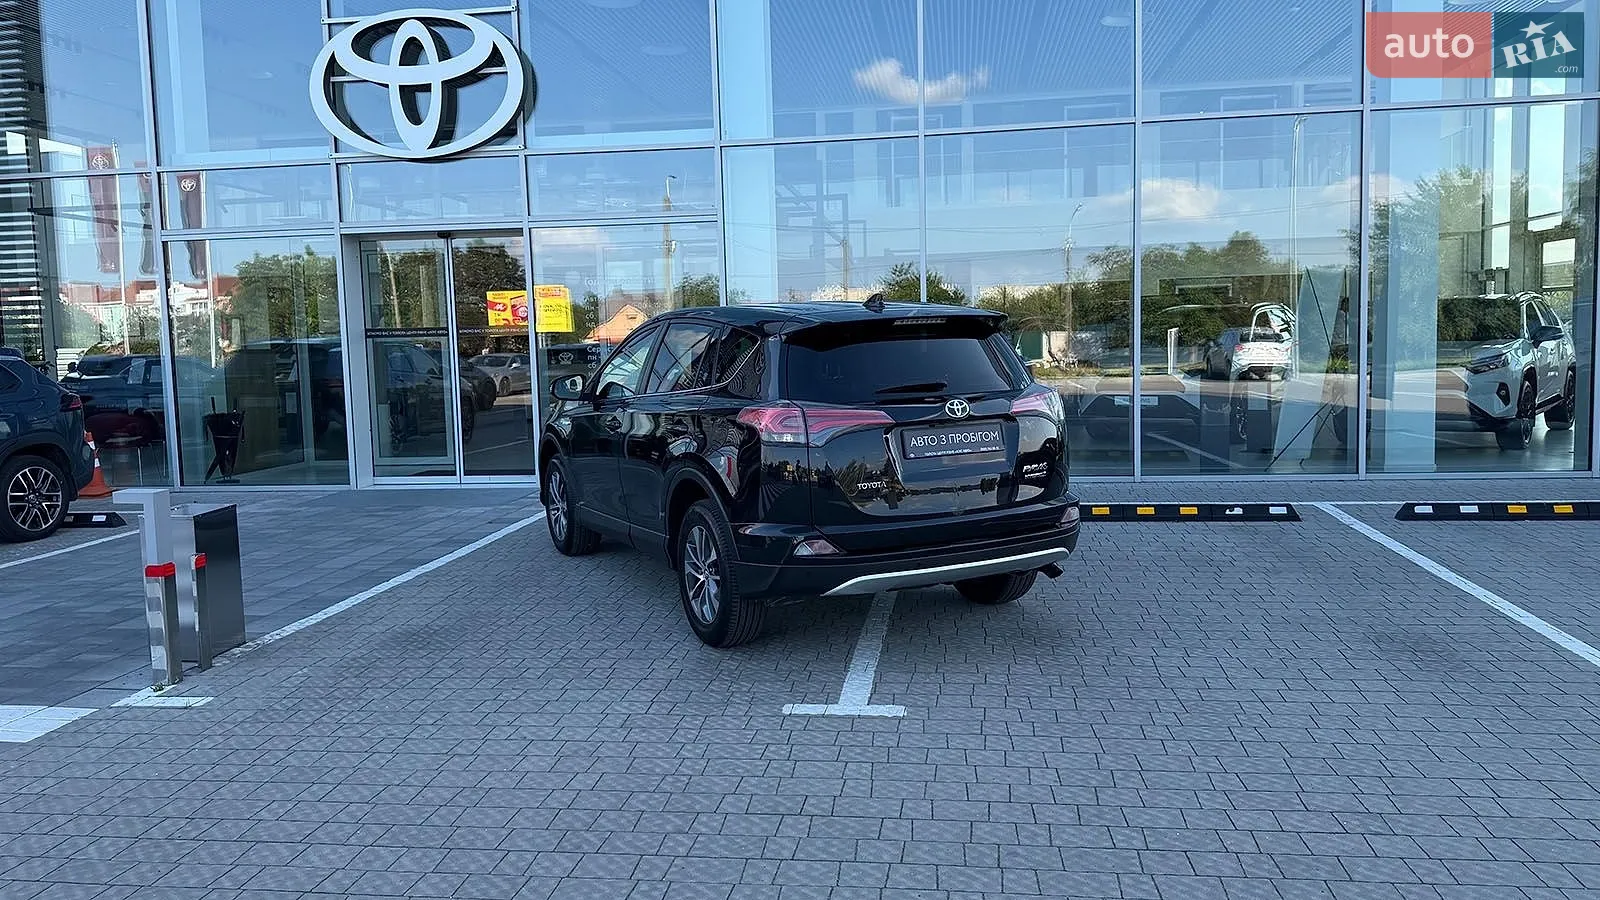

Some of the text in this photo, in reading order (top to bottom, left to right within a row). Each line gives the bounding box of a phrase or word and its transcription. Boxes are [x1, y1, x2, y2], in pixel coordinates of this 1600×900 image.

[910, 435, 938, 448] АВТО
[948, 431, 1000, 445] ПРОБІГОМ
[857, 481, 887, 490] TOYOTA
